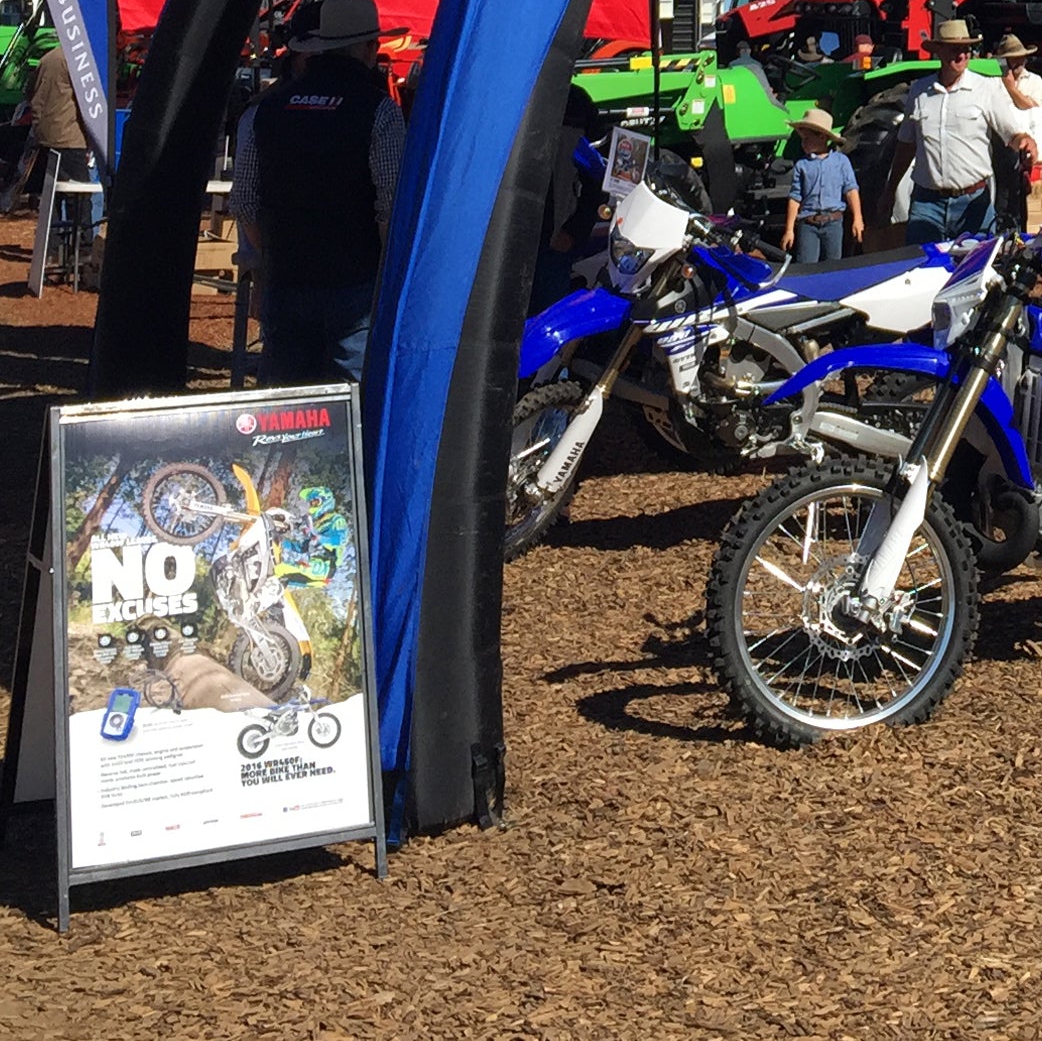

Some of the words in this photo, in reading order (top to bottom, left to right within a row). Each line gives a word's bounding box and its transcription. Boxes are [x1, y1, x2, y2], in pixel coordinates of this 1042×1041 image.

[289, 95, 329, 105] CASE
[257, 407, 331, 432] YAMAHA
[553, 442, 585, 483] YAMAHA
[91, 542, 196, 605] NO
[92, 593, 199, 624] EXCUSES
[241, 762, 262, 772] 2016
[241, 769, 267, 779] MORE
[270, 765, 291, 776] BIKE
[293, 761, 316, 772] THAN
[241, 777, 259, 787] YOU
[262, 774, 283, 784] WILL
[286, 770, 308, 781] EVER
